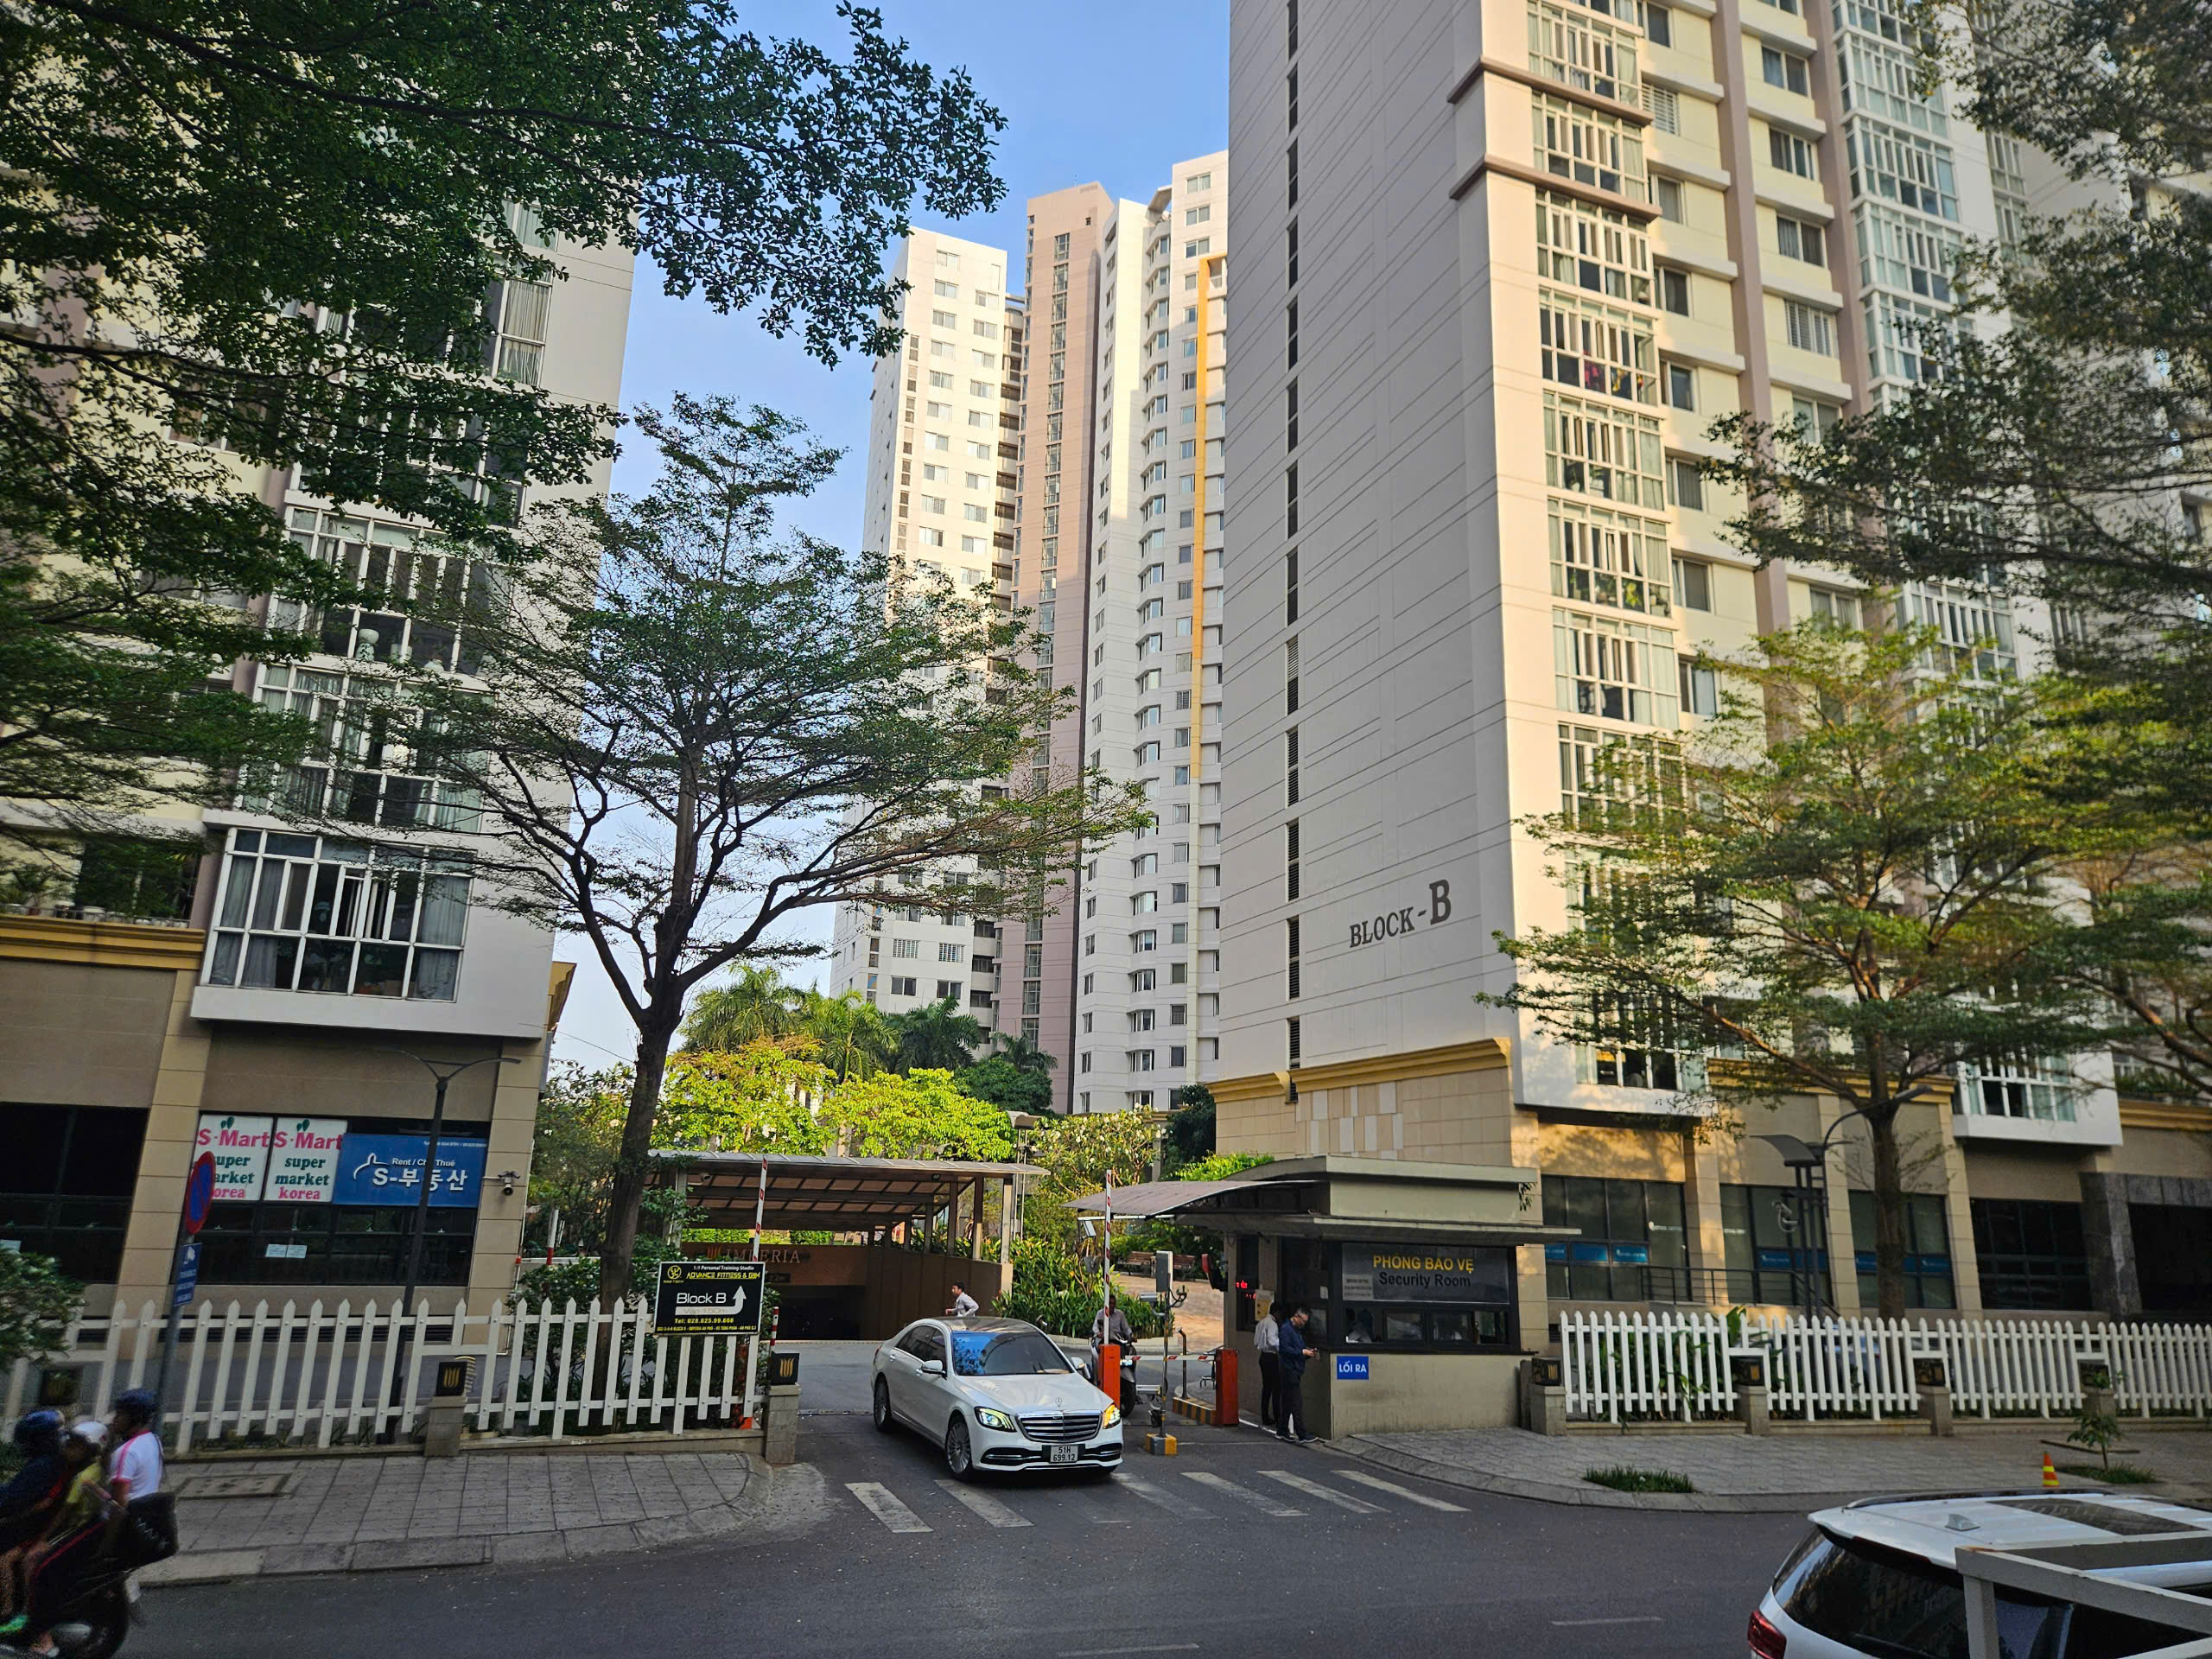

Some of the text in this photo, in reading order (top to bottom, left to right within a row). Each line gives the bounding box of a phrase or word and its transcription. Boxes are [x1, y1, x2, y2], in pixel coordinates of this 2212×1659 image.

[214, 1156, 251, 1168] uper
[285, 1157, 327, 1170] super
[214, 1171, 256, 1185] arket
[275, 1173, 330, 1185] market
[213, 1188, 246, 1198] orea
[278, 1186, 321, 1200] korea
[1379, 1271, 1471, 1289] Security Room
[676, 1292, 727, 1304] Block B
[1339, 1360, 1367, 1373] LỐI RA
[1058, 1446, 1071, 1454] 51H
[1052, 1453, 1076, 1462] 699.12
